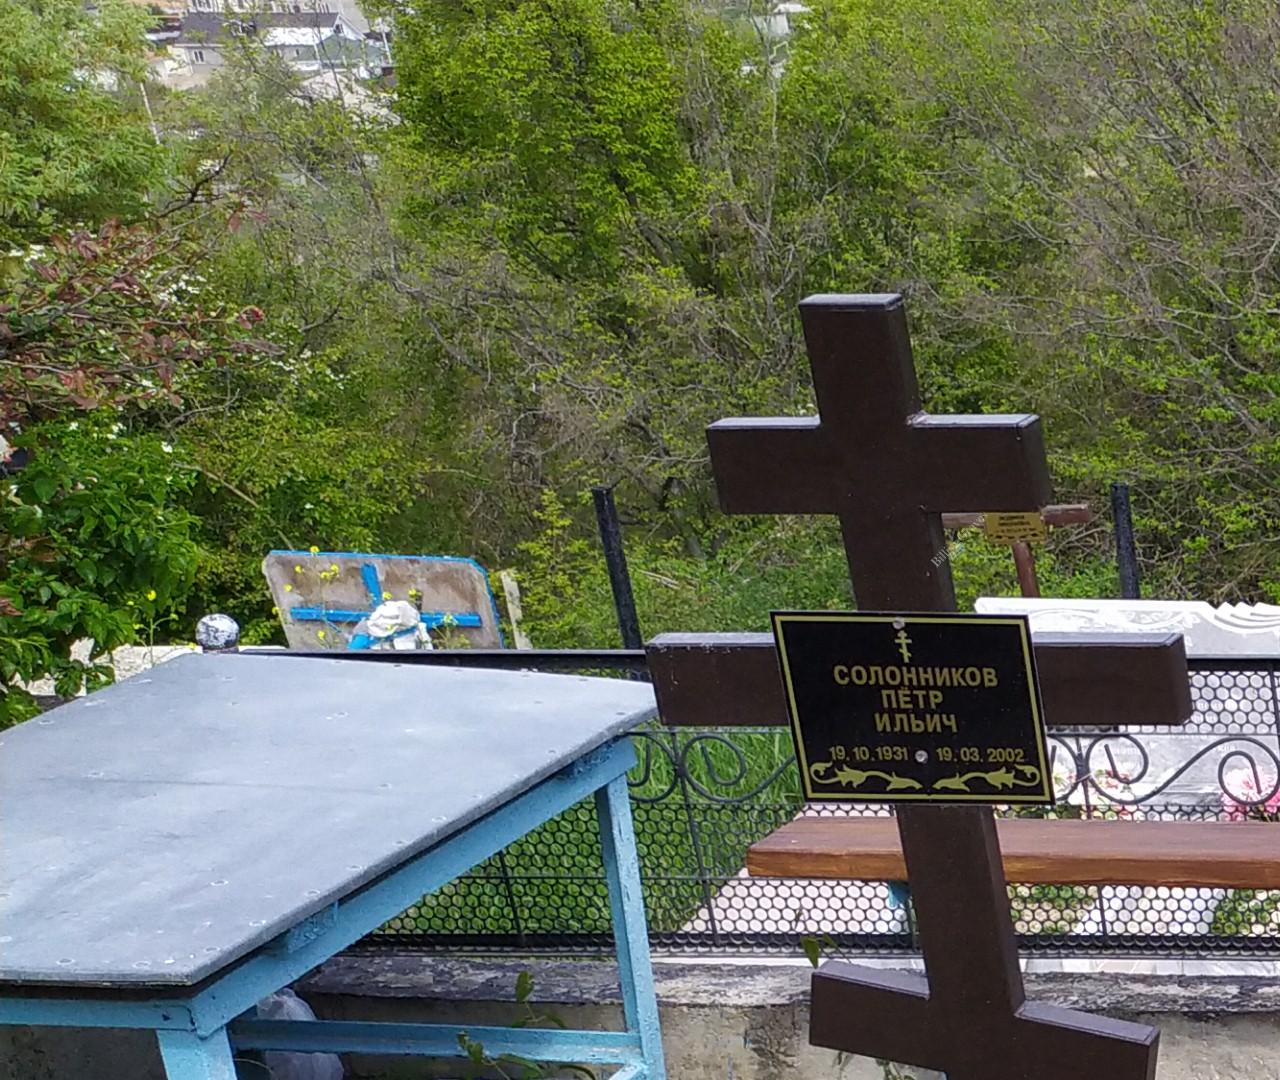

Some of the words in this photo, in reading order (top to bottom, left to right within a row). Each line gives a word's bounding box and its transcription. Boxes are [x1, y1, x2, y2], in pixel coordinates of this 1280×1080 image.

[833, 664, 999, 687] СОЛОННИКОВ
[881, 687, 944, 710] ПЁТР
[873, 712, 958, 733] ИЛЬИЧ
